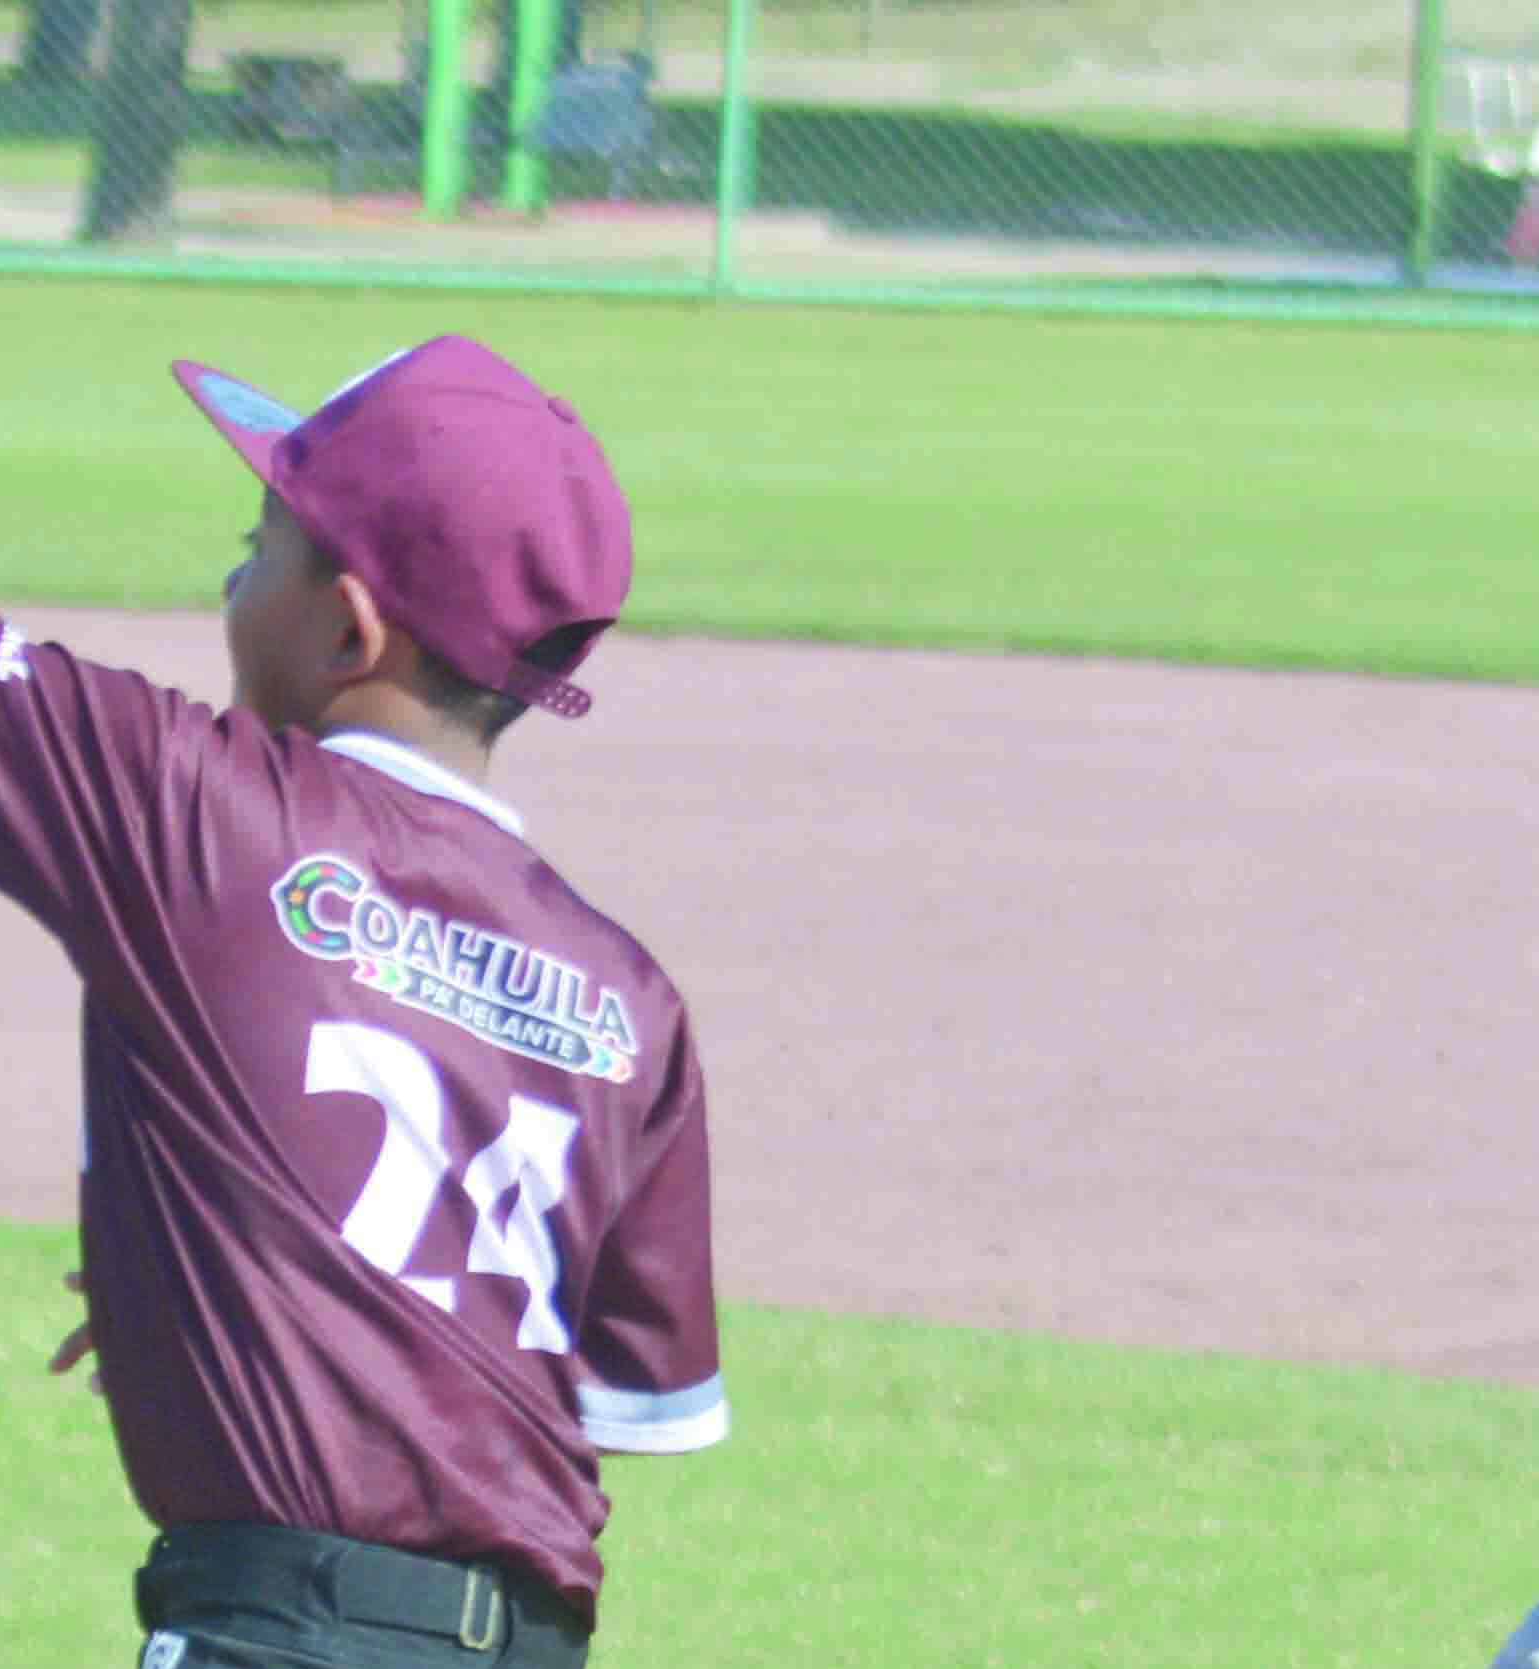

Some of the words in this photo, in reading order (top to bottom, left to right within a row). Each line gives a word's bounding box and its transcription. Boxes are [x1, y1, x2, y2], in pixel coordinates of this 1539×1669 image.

[271, 854, 640, 1053] COAHUILA
[463, 1003, 577, 1059] DELANTE
[304, 1021, 581, 1355] 24
